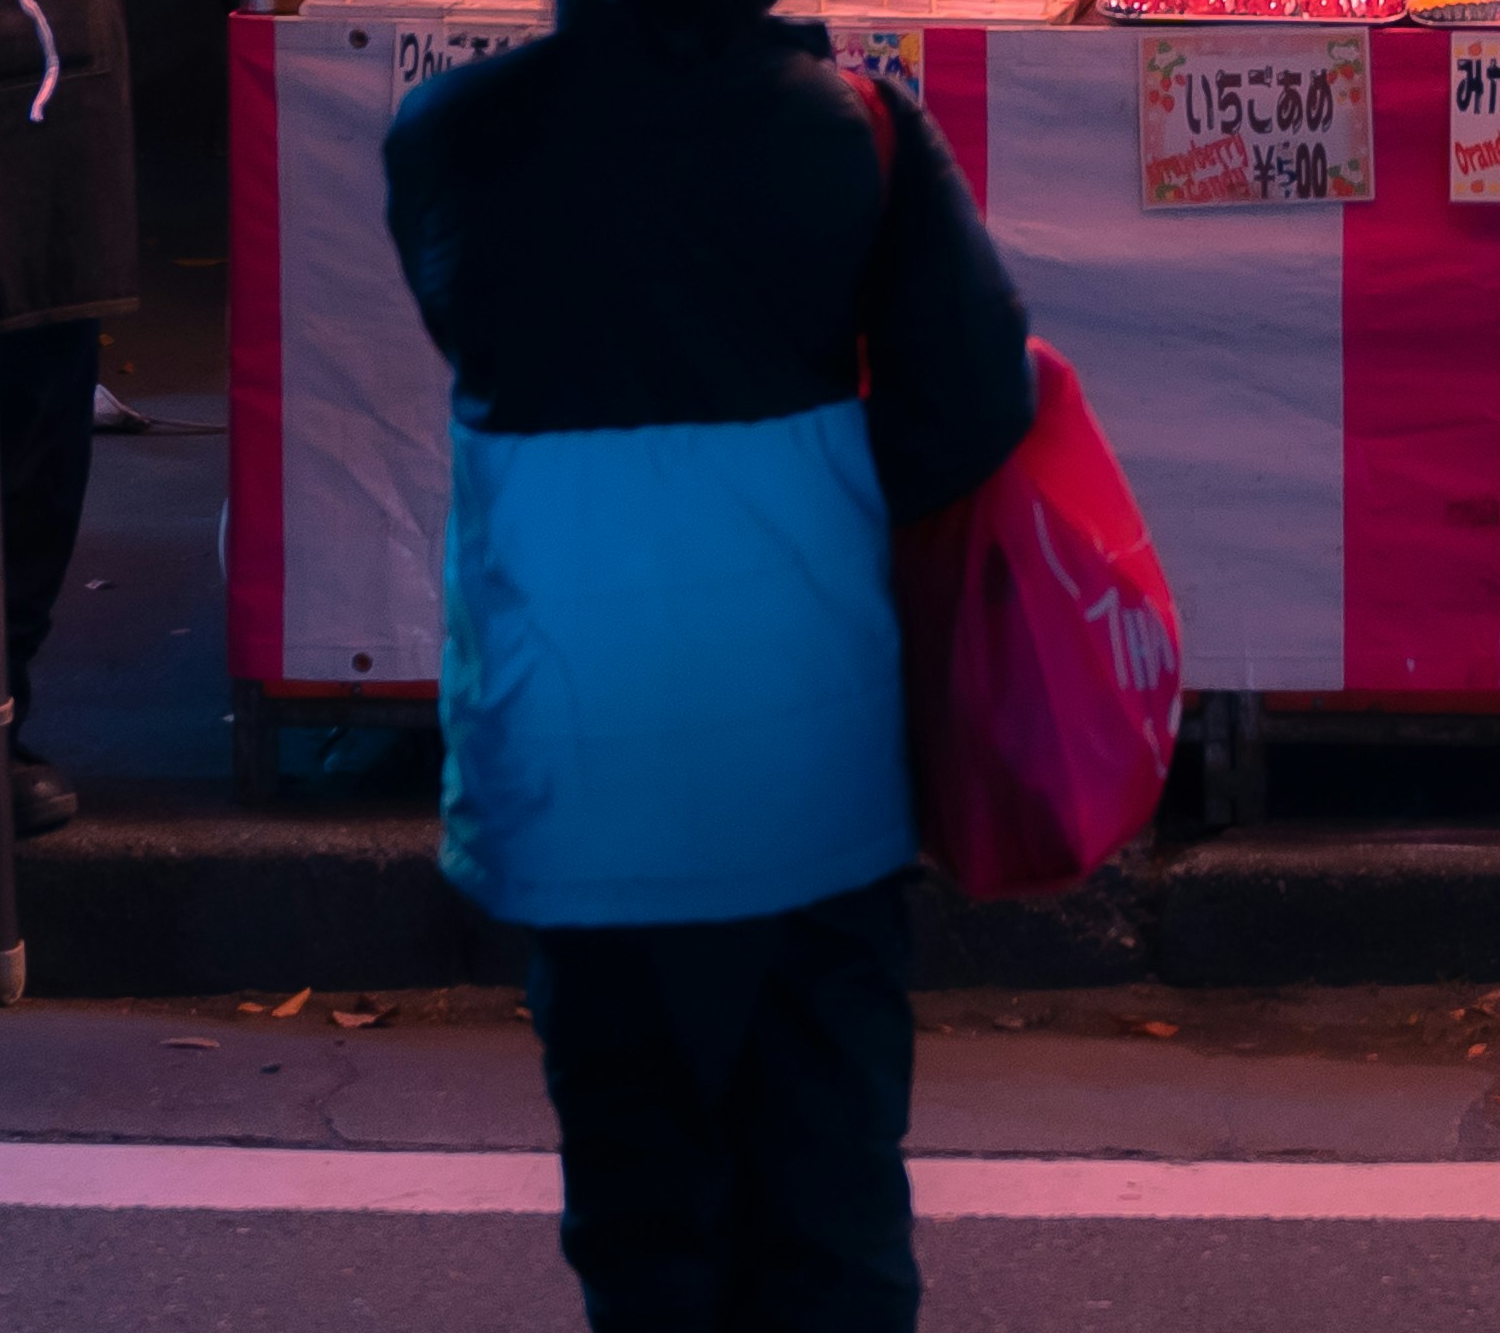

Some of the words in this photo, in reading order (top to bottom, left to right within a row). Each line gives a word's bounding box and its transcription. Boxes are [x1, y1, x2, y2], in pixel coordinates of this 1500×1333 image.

[1186, 66, 1334, 135] いちごあめ
[1253, 141, 1328, 199] ¥500
